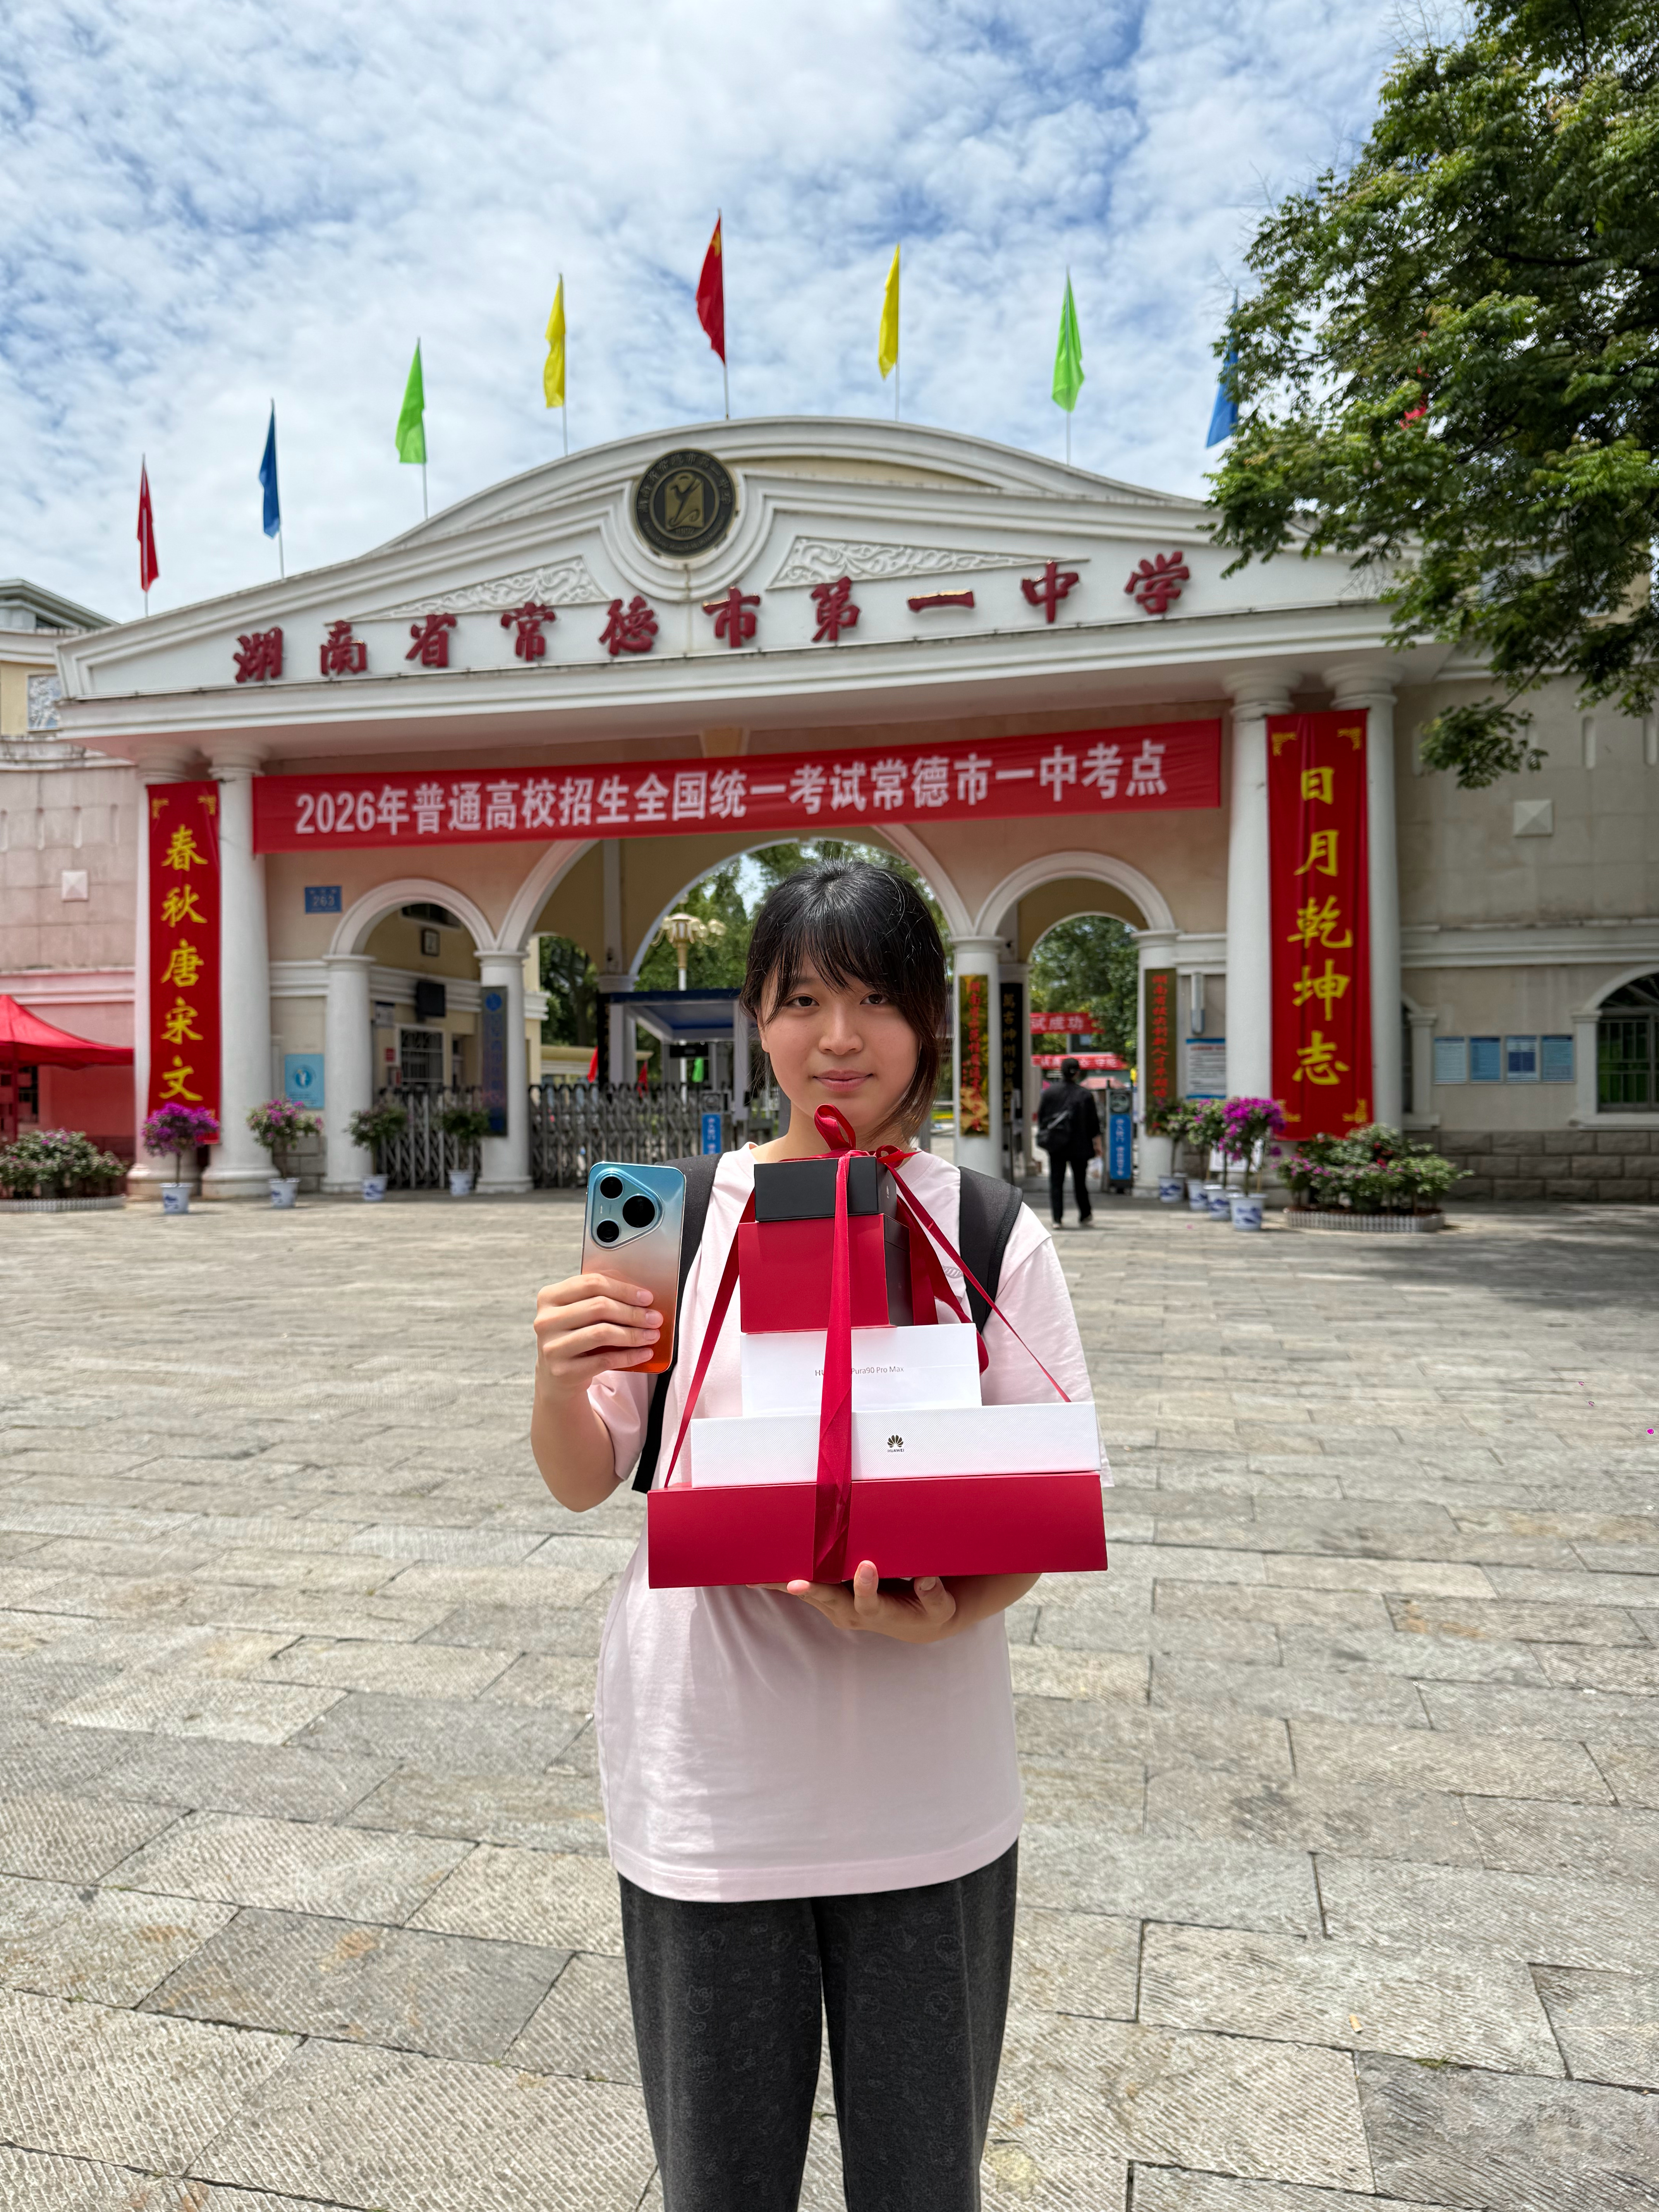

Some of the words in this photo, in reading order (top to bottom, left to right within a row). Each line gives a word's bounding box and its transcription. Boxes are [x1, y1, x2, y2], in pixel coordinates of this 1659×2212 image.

[234, 550, 1190, 684] 湖南省常德市第一中学
[295, 738, 1167, 836] 2026年普通高校招生全国统一考试常德市一中考点
[158, 823, 209, 1103] 春秋唐宋文
[1286, 765, 1354, 1086] 日月乾坤志
